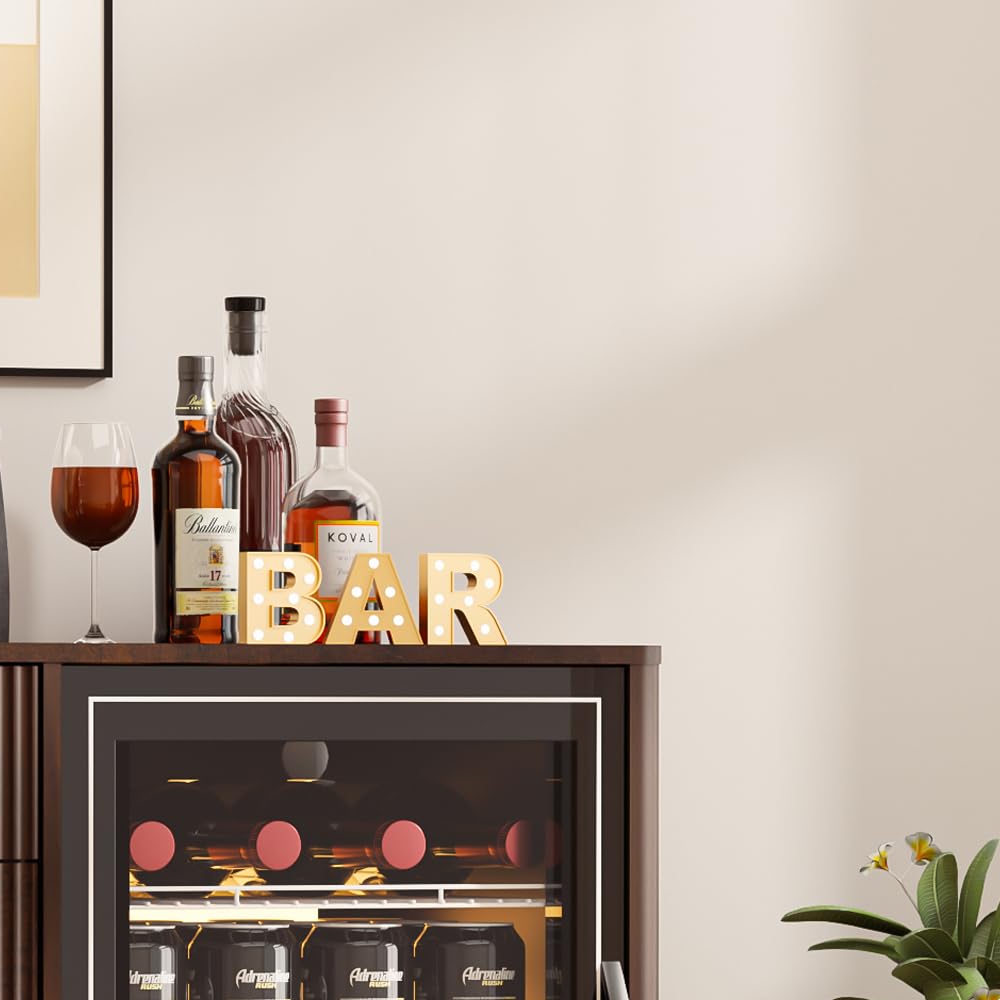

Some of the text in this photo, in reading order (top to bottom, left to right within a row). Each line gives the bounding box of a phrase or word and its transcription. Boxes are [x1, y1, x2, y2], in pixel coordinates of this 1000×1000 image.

[327, 532, 374, 543] KOVAL
[210, 570, 222, 581] 17
[238, 551, 508, 646] BAR
